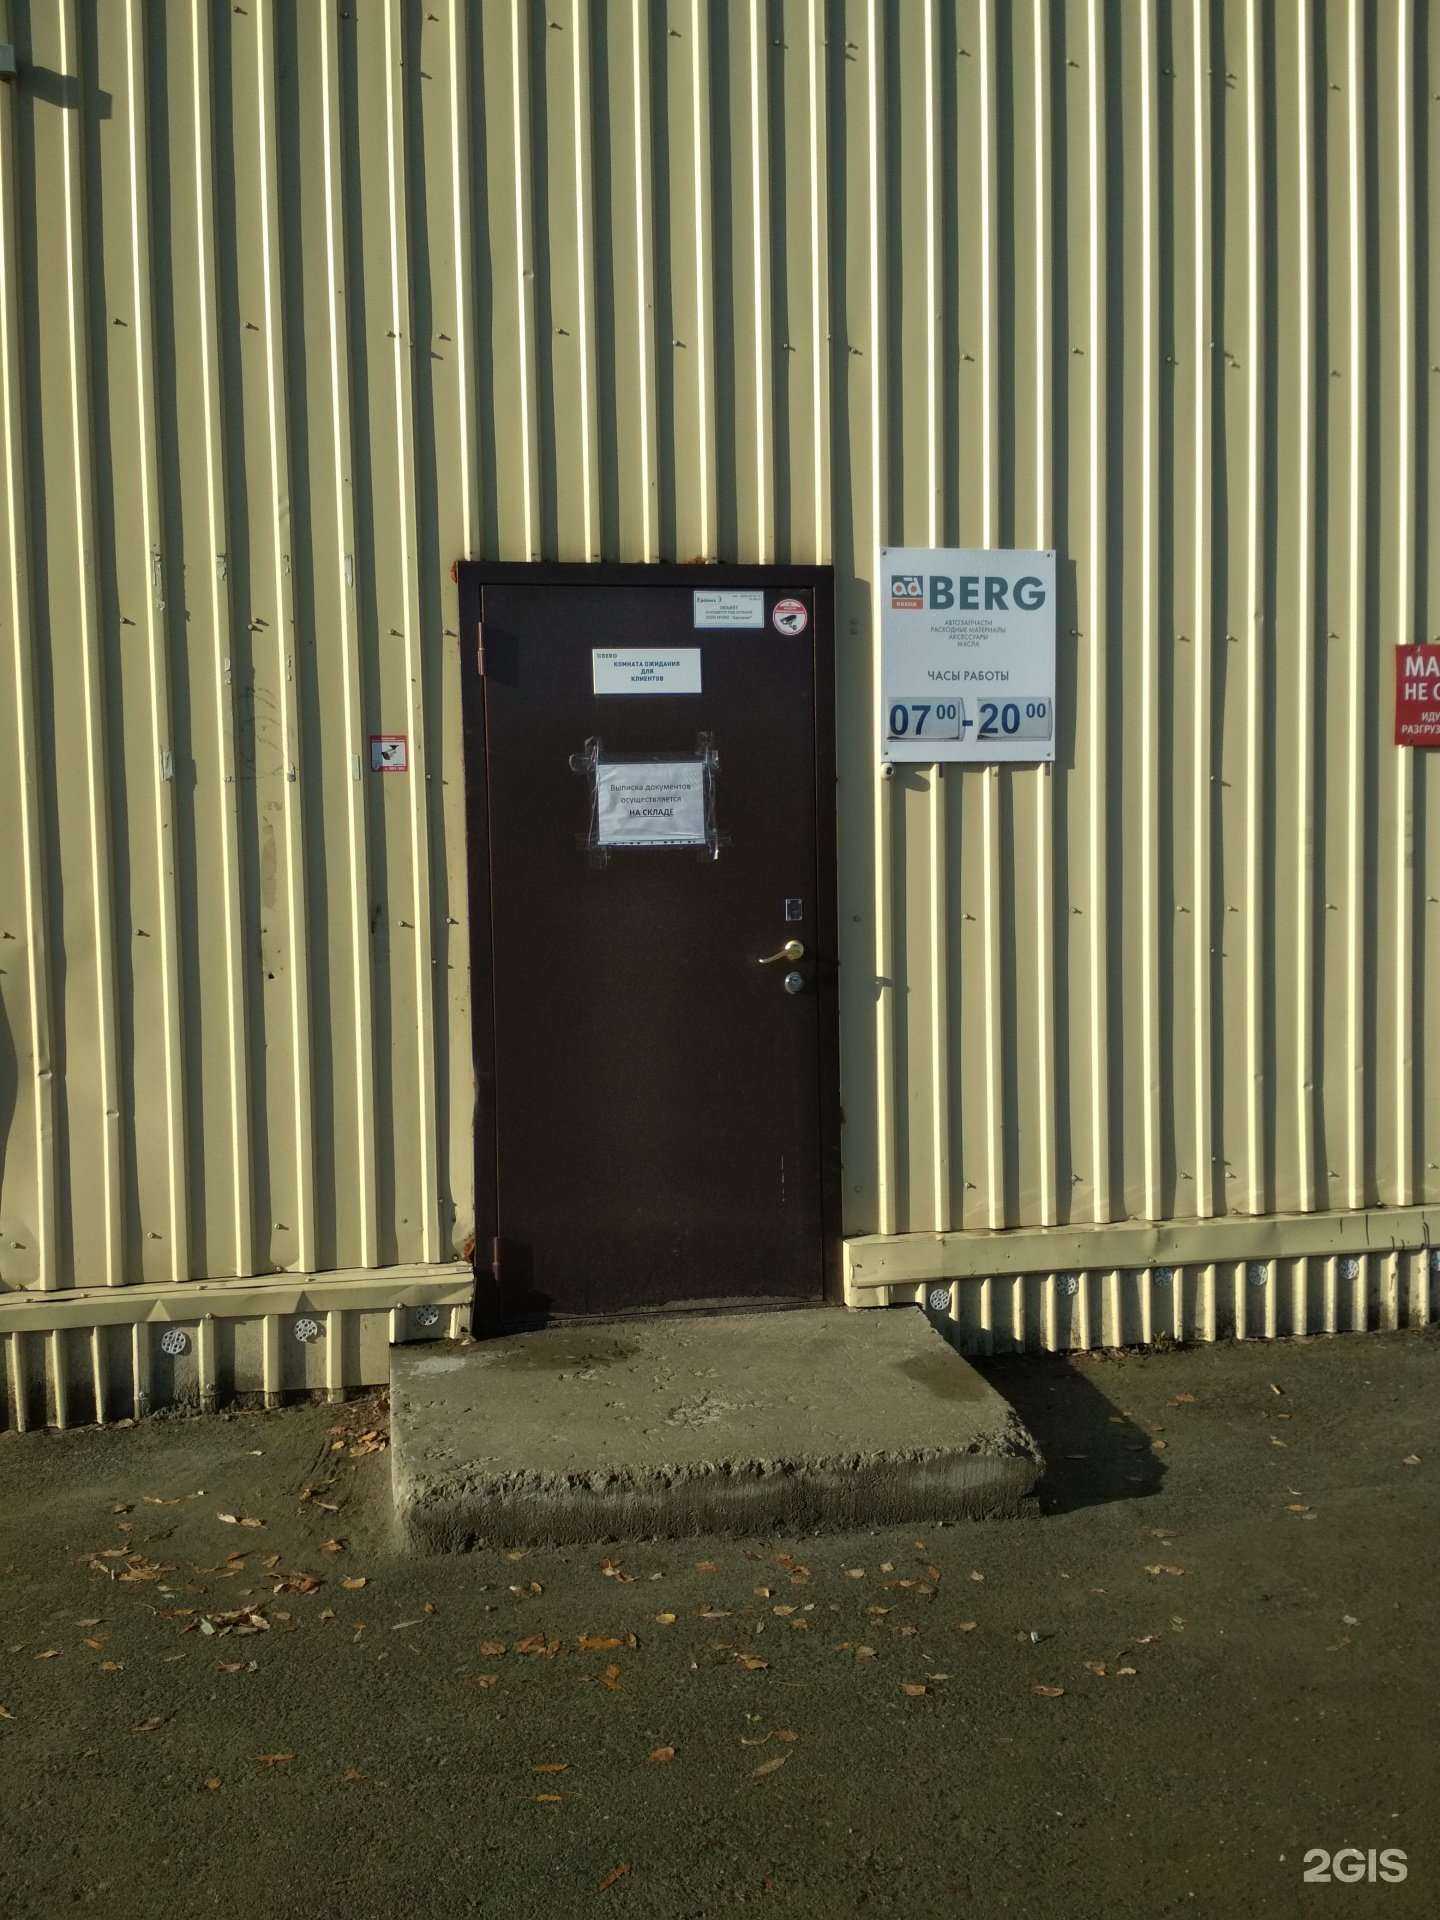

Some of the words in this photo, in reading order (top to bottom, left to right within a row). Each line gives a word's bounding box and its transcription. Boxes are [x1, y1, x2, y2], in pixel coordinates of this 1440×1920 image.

[929, 576, 1046, 611] BERG
[928, 671, 960, 681] ЧАСЫ
[963, 671, 1009, 681] РАБОТЫ
[1404, 682, 1428, 701] НЕ
[610, 784, 643, 792] Выписка
[645, 783, 692, 792] документов
[642, 808, 674, 817] СКЛАДЕ
